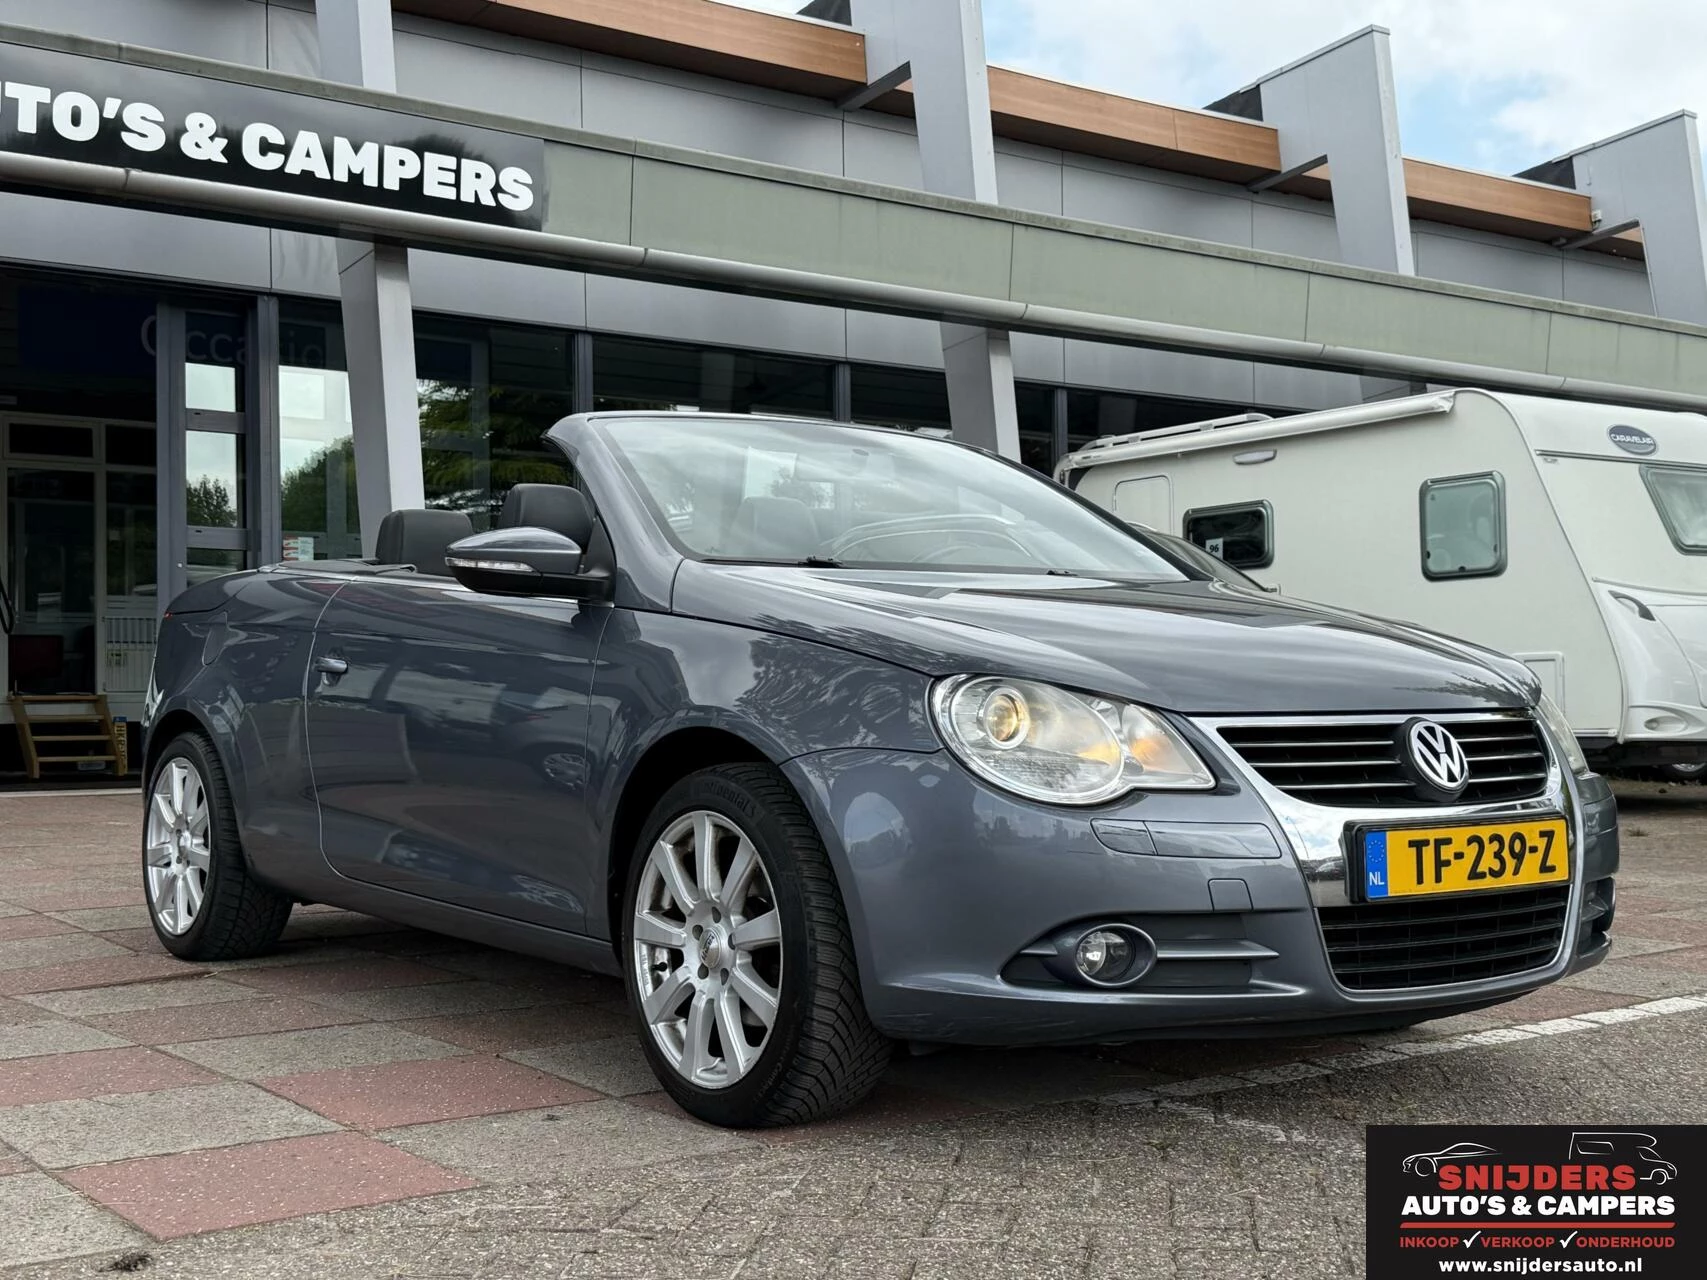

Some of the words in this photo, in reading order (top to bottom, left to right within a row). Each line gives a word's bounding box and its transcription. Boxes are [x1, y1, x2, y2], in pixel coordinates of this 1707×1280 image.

[0, 81, 167, 152] TO'S
[180, 112, 229, 164] &
[241, 122, 535, 211] CAMPERS
[1610, 434, 1654, 445] CARAVELAIR
[1209, 544, 1220, 553] 96
[1410, 721, 1468, 788] VW
[1408, 829, 1556, 885] TF-239-Z
[1369, 872, 1384, 885] NL
